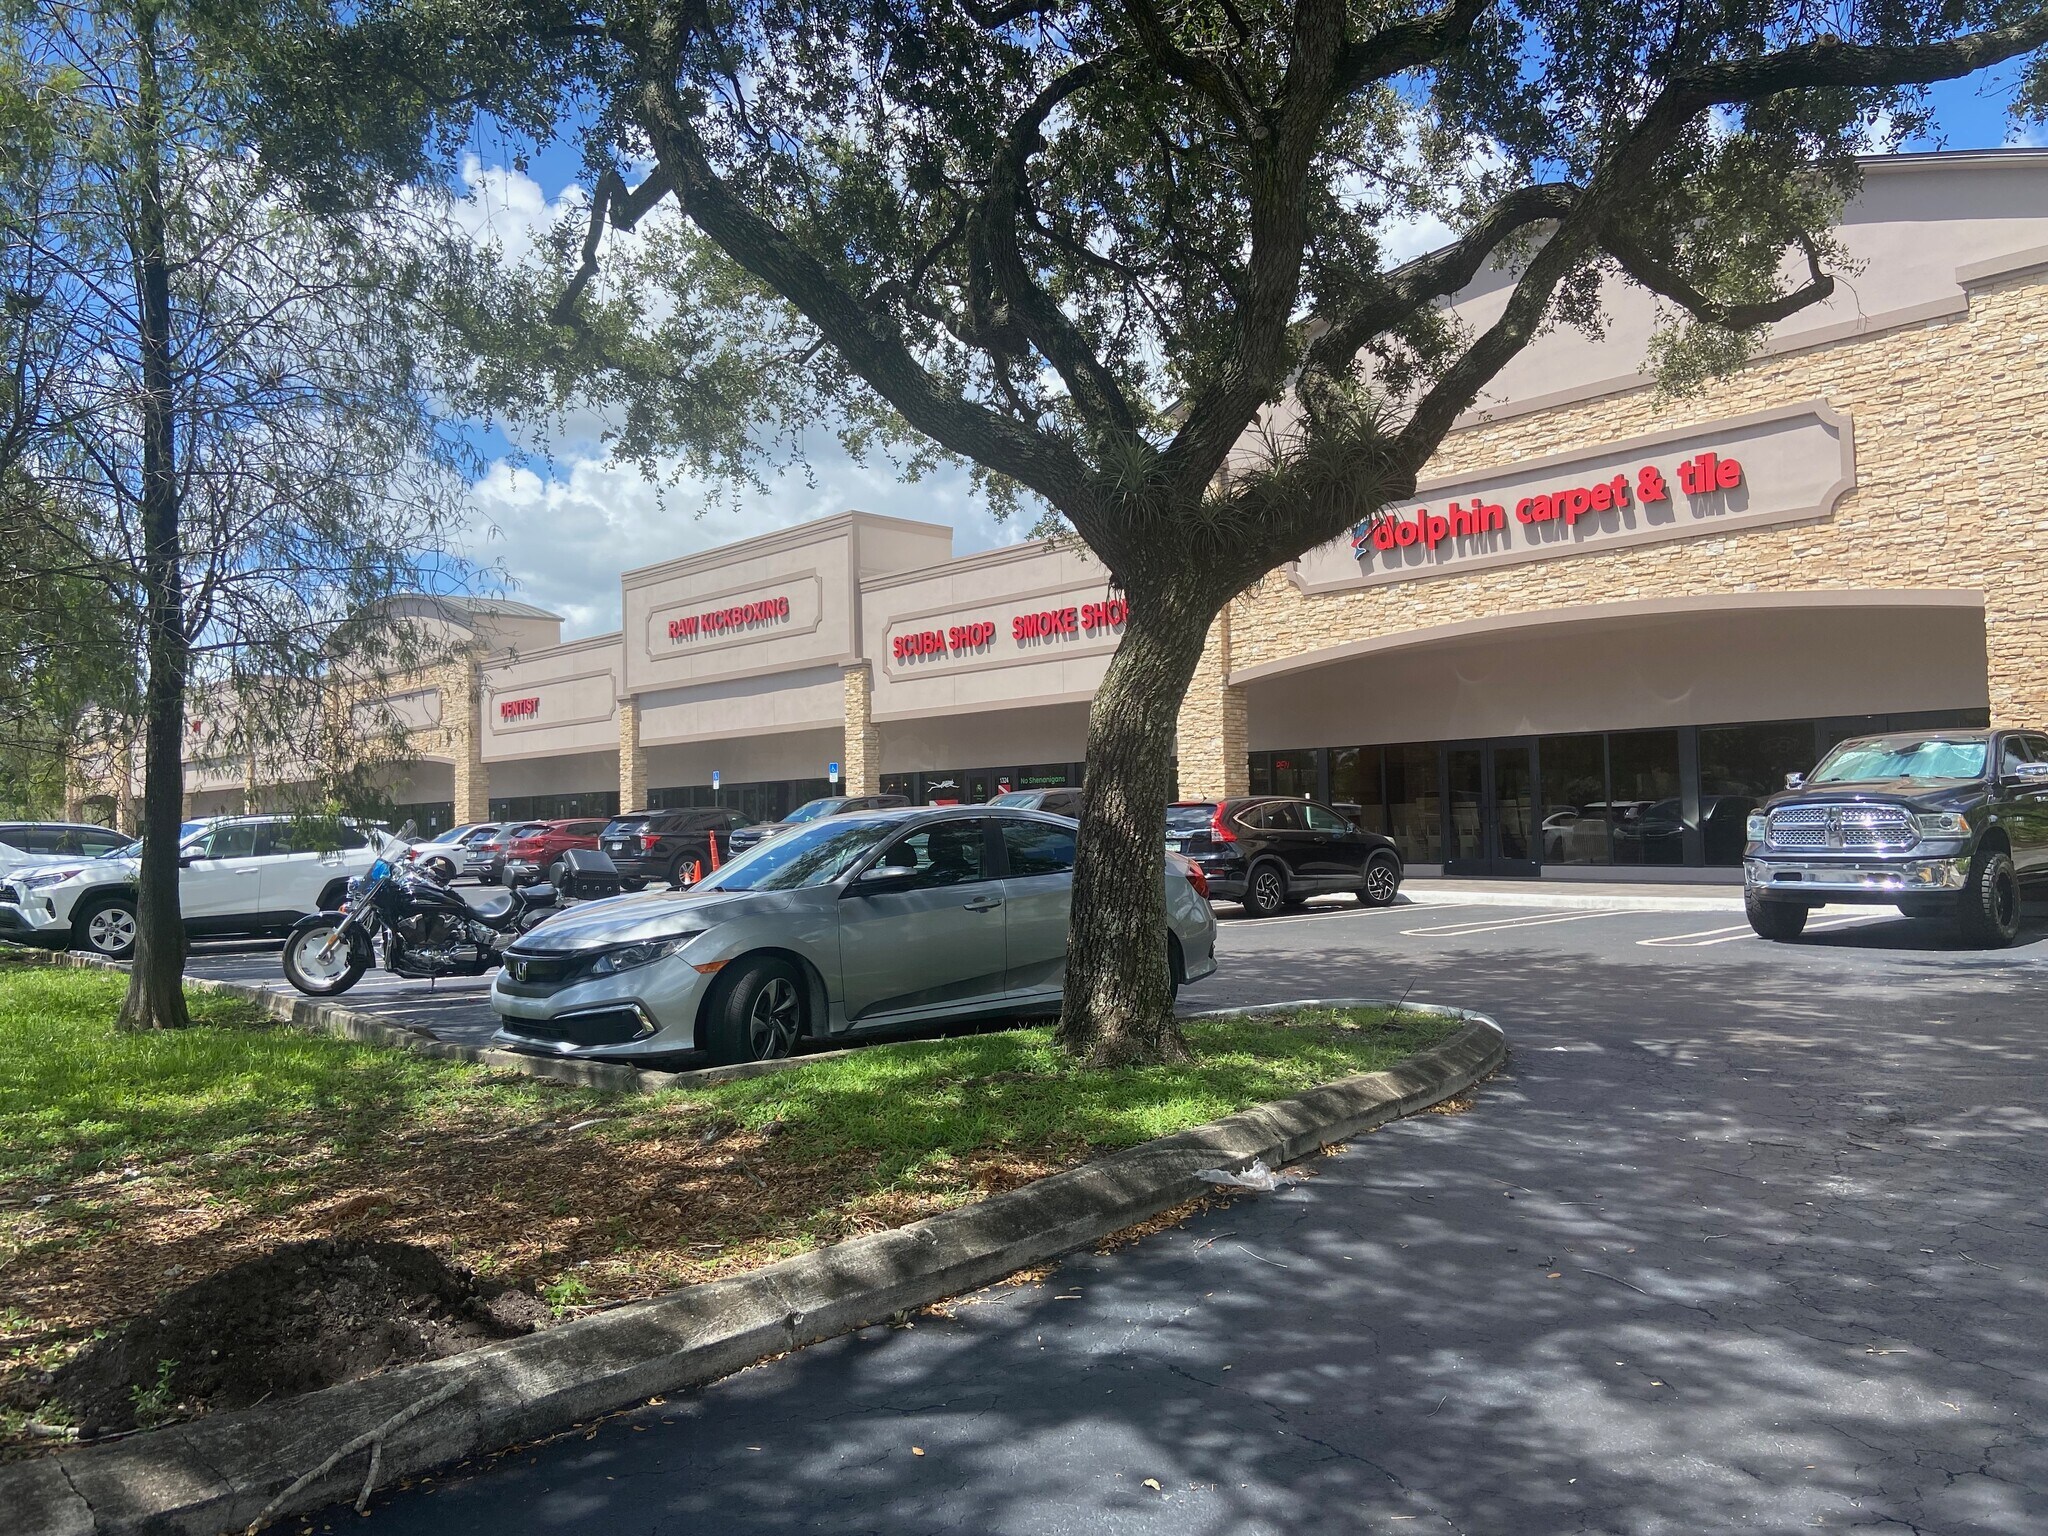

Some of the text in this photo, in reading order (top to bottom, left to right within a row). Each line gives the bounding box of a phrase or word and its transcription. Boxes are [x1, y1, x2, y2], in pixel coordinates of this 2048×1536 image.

[1373, 452, 1742, 550] dolphin carpet & tile
[668, 596, 788, 638] RAW KICKBOXING
[1011, 606, 1077, 640] SMOKE
[892, 621, 995, 659] SCUBA SHOP
[500, 697, 537, 718] DENTIST
[1029, 775, 1066, 785] Shenanigans
